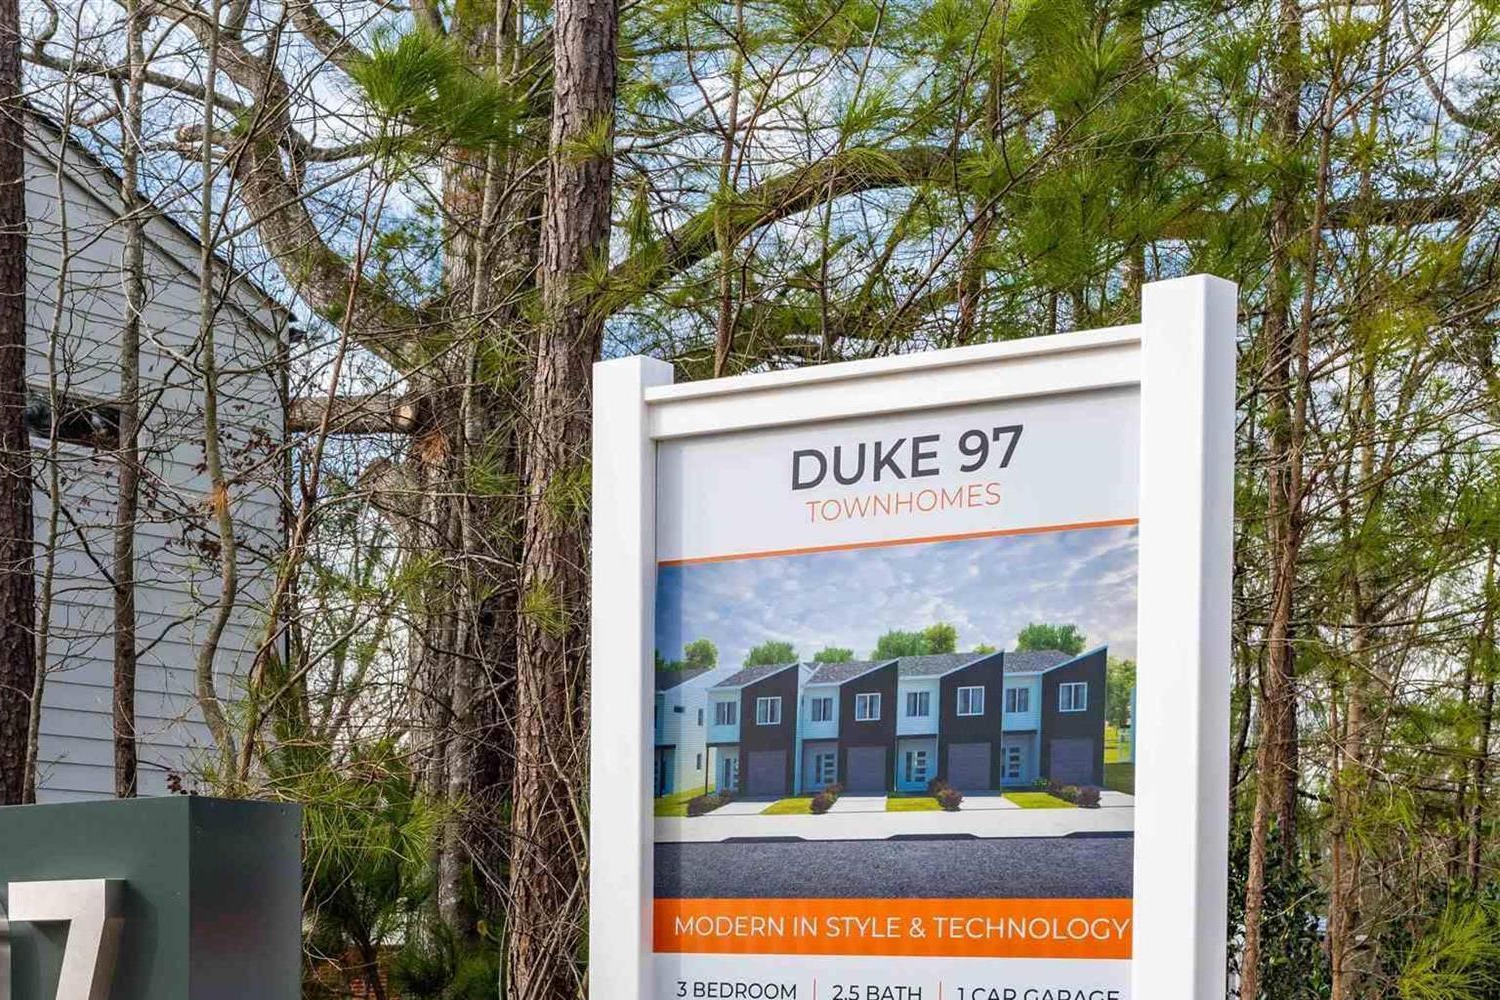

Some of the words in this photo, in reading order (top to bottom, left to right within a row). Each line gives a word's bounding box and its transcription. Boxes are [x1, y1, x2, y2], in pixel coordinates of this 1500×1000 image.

[791, 434, 941, 491] DUKE
[959, 425, 1023, 472] 97
[805, 482, 1001, 523] TOWNHOMES
[674, 916, 784, 937] MODERN
[794, 917, 817, 936] IN
[827, 917, 900, 937] STYLE
[909, 916, 925, 937] &
[933, 917, 1129, 939] TECHNOLOGY
[677, 982, 686, 997] 3
[694, 982, 796, 1000] BEDROOM
[833, 985, 859, 1000] 2.5
